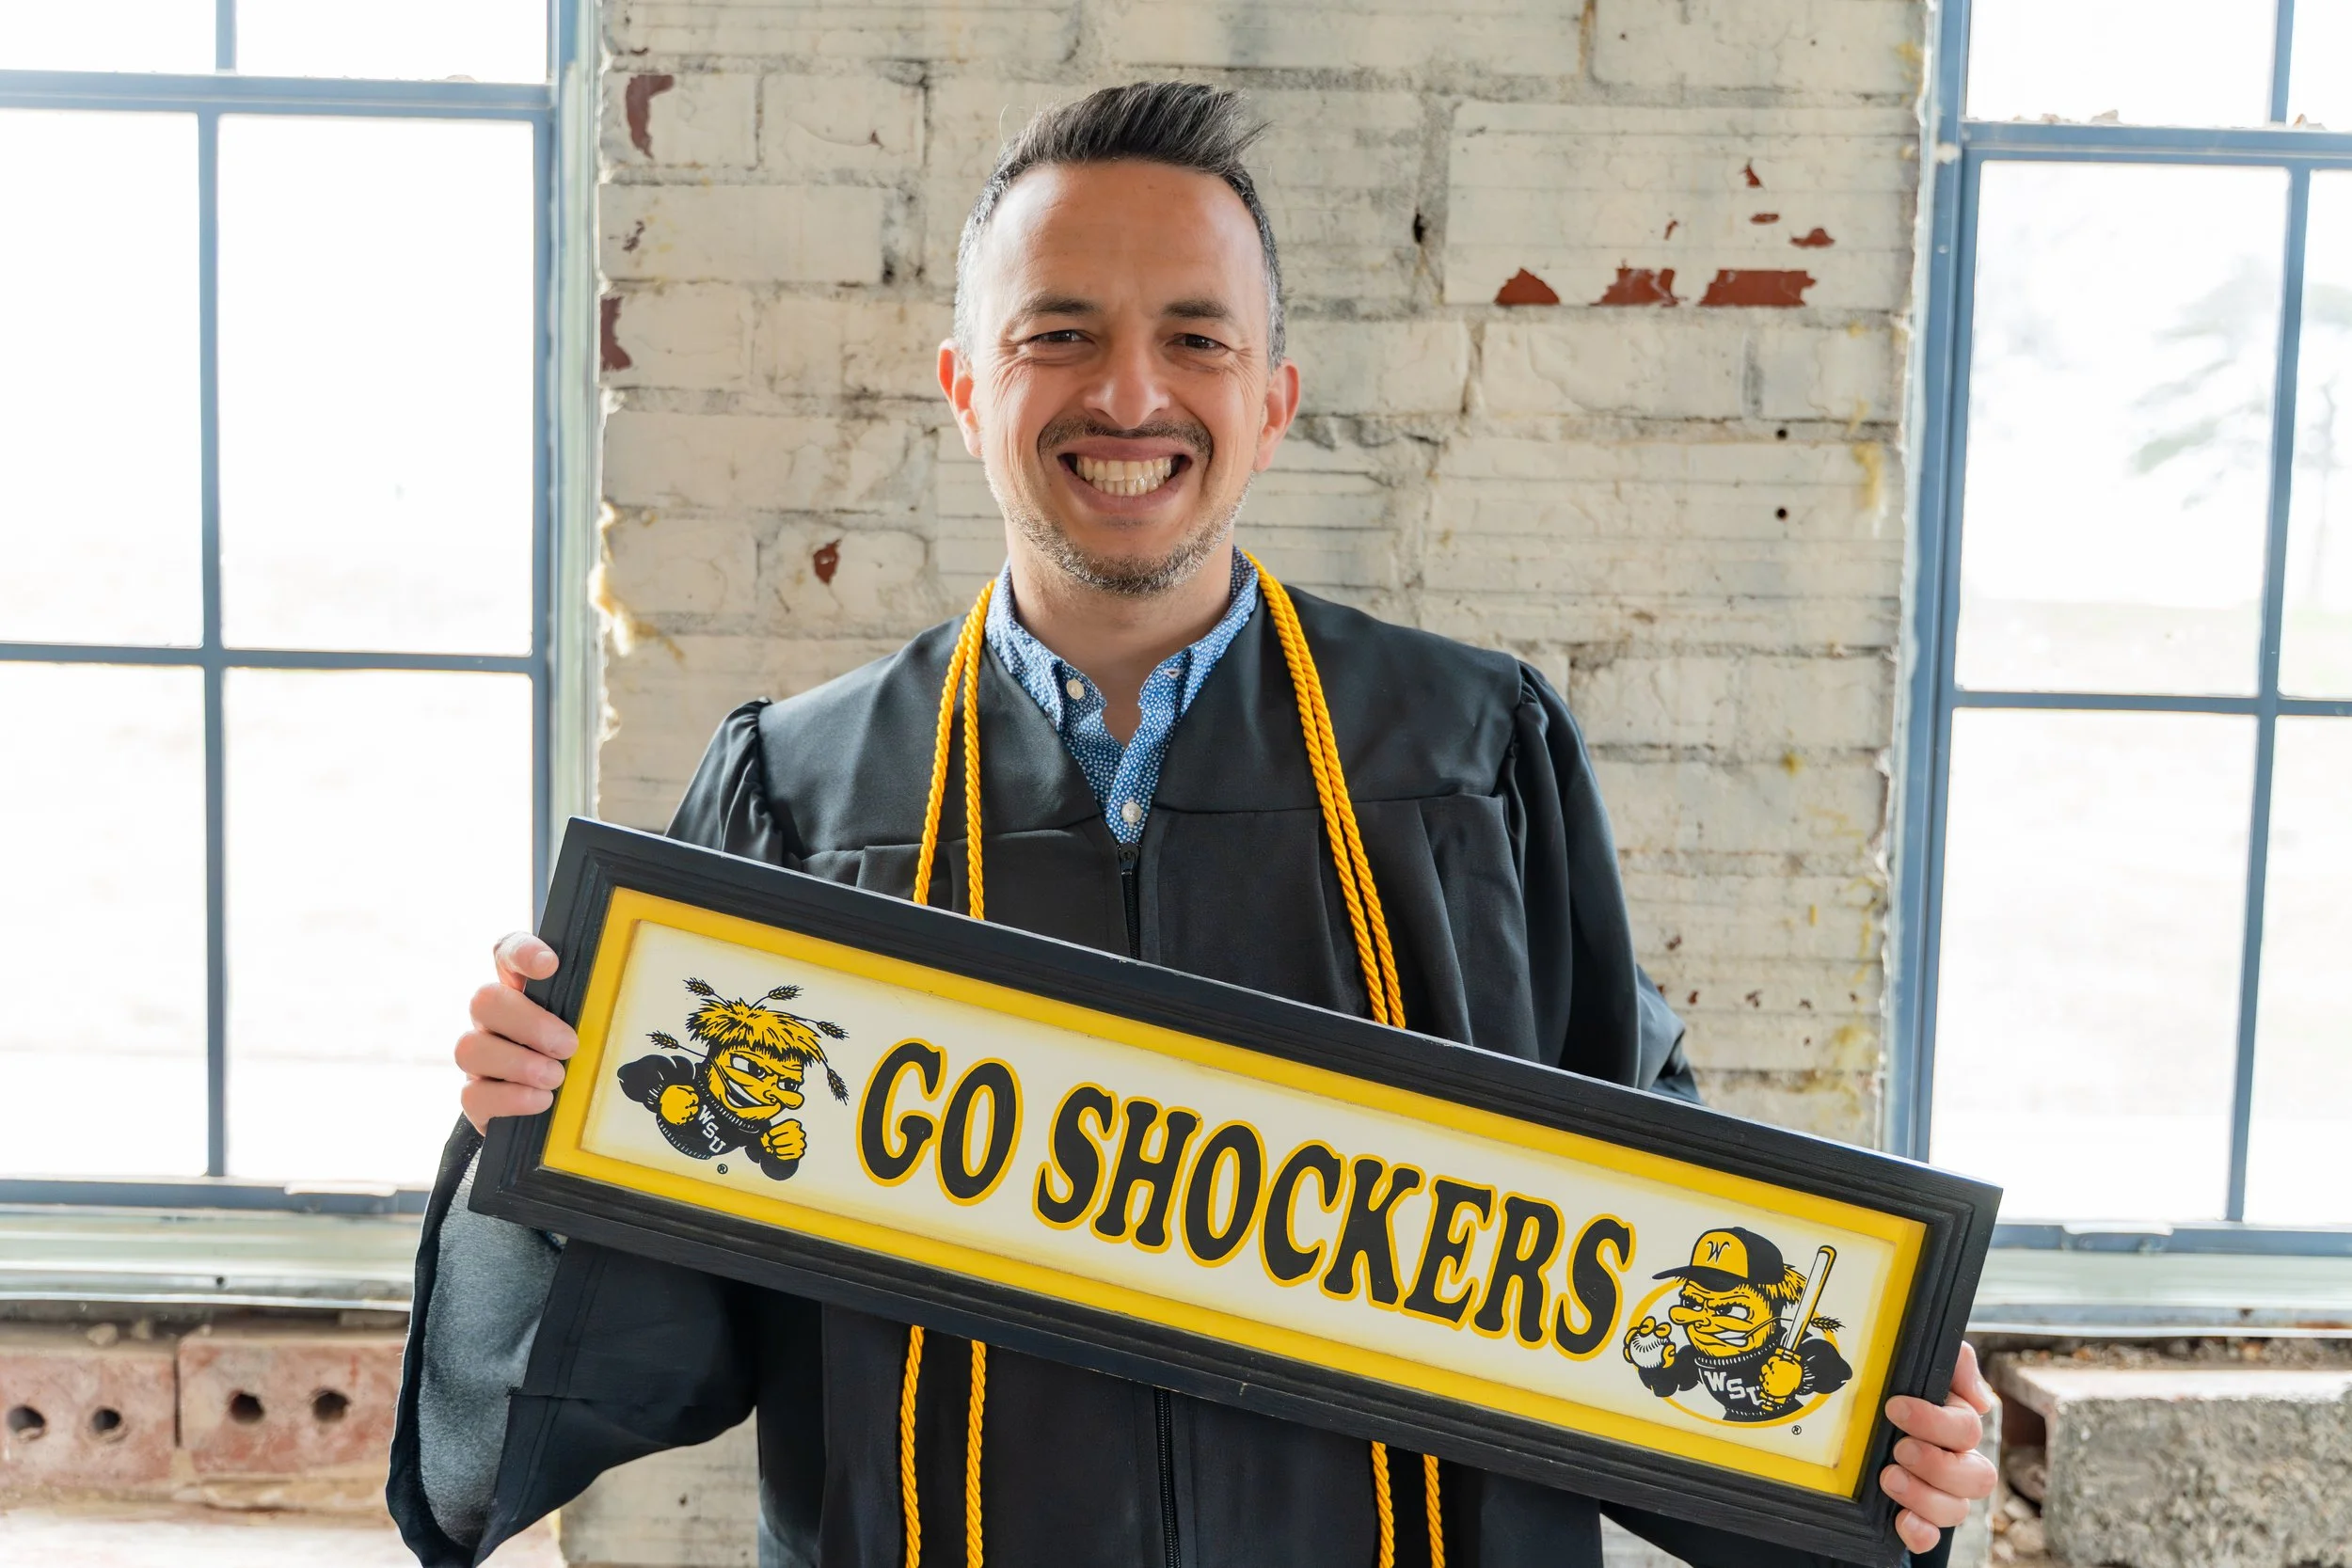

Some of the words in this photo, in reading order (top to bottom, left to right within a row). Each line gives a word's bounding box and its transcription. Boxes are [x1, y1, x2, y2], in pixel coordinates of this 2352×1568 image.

[698, 1104, 726, 1153] WSU
[855, 1037, 1025, 1207] GO
[1032, 1082, 1635, 1362] SHOCKERS
[1706, 1240, 1730, 1264] W
